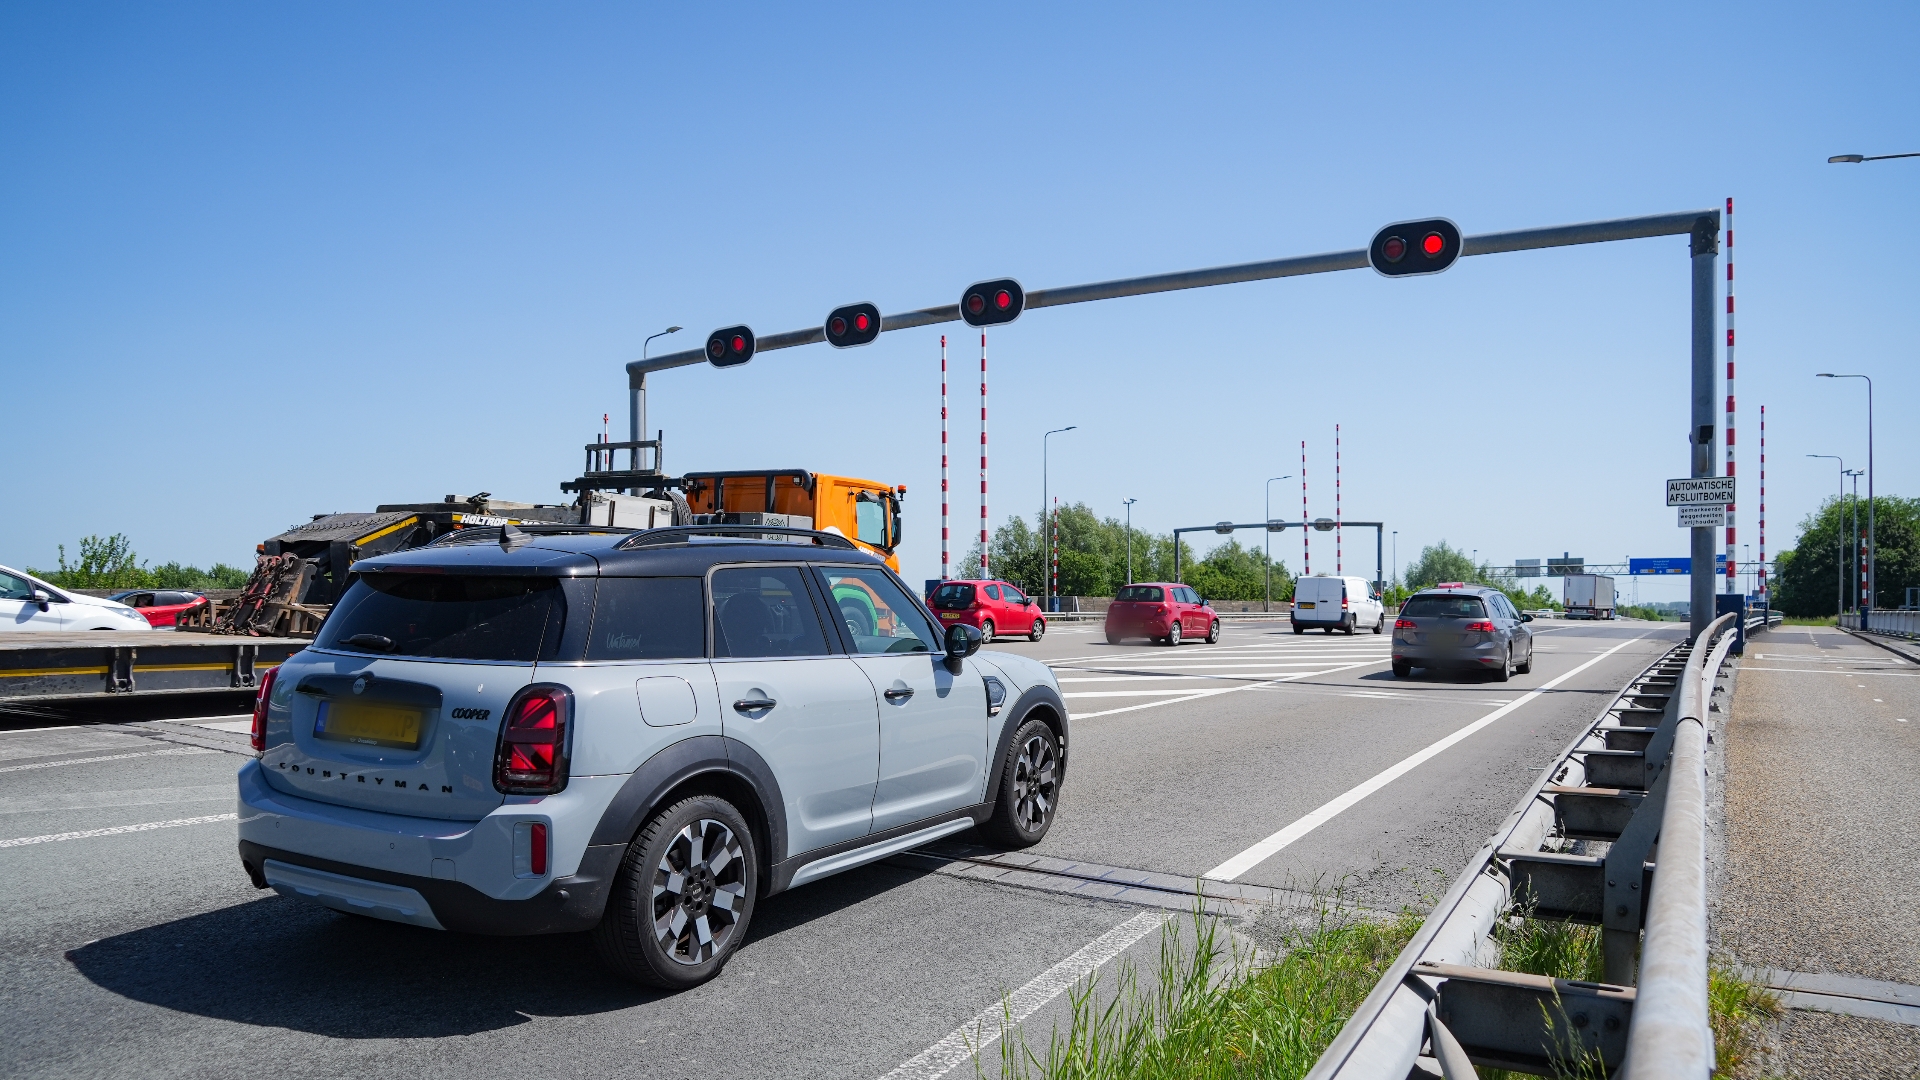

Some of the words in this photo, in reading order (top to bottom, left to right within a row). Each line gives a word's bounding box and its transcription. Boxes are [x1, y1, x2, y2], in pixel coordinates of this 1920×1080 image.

[1669, 480, 1733, 491] AUTOMATISCHE
[1669, 491, 1733, 502] AFSLUITBOMEN
[460, 514, 508, 526] HOLTROP
[451, 707, 490, 720] COOPER
[279, 762, 453, 793] COUNTRYMAN
